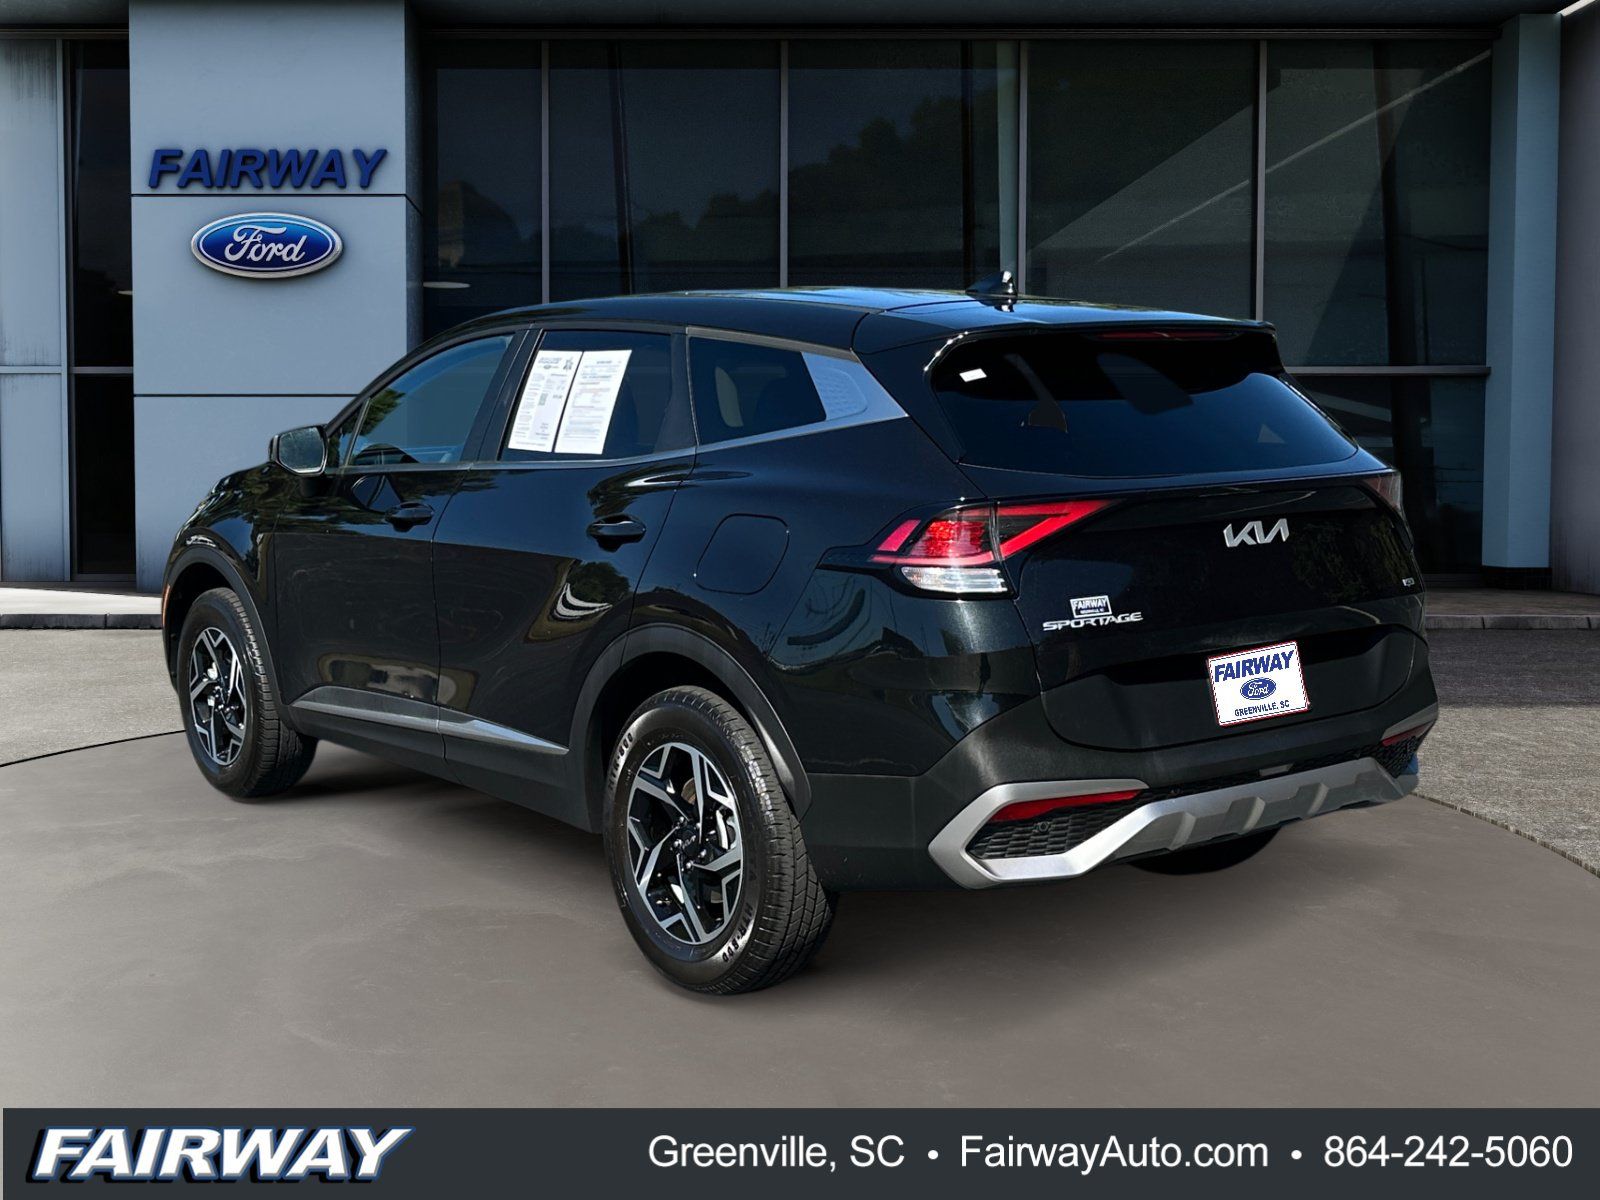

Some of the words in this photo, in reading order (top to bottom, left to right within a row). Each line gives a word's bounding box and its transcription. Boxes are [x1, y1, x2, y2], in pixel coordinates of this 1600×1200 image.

[148, 148, 388, 189] FAIRWAY
[224, 224, 308, 262] Ford
[1223, 518, 1290, 548] KIA
[1073, 598, 1108, 610] FAIRWAY
[1042, 612, 1144, 631] SPORTAGE
[1214, 650, 1295, 682] FAIRWAY
[1247, 681, 1270, 697] Ford
[1280, 700, 1290, 709] SC
